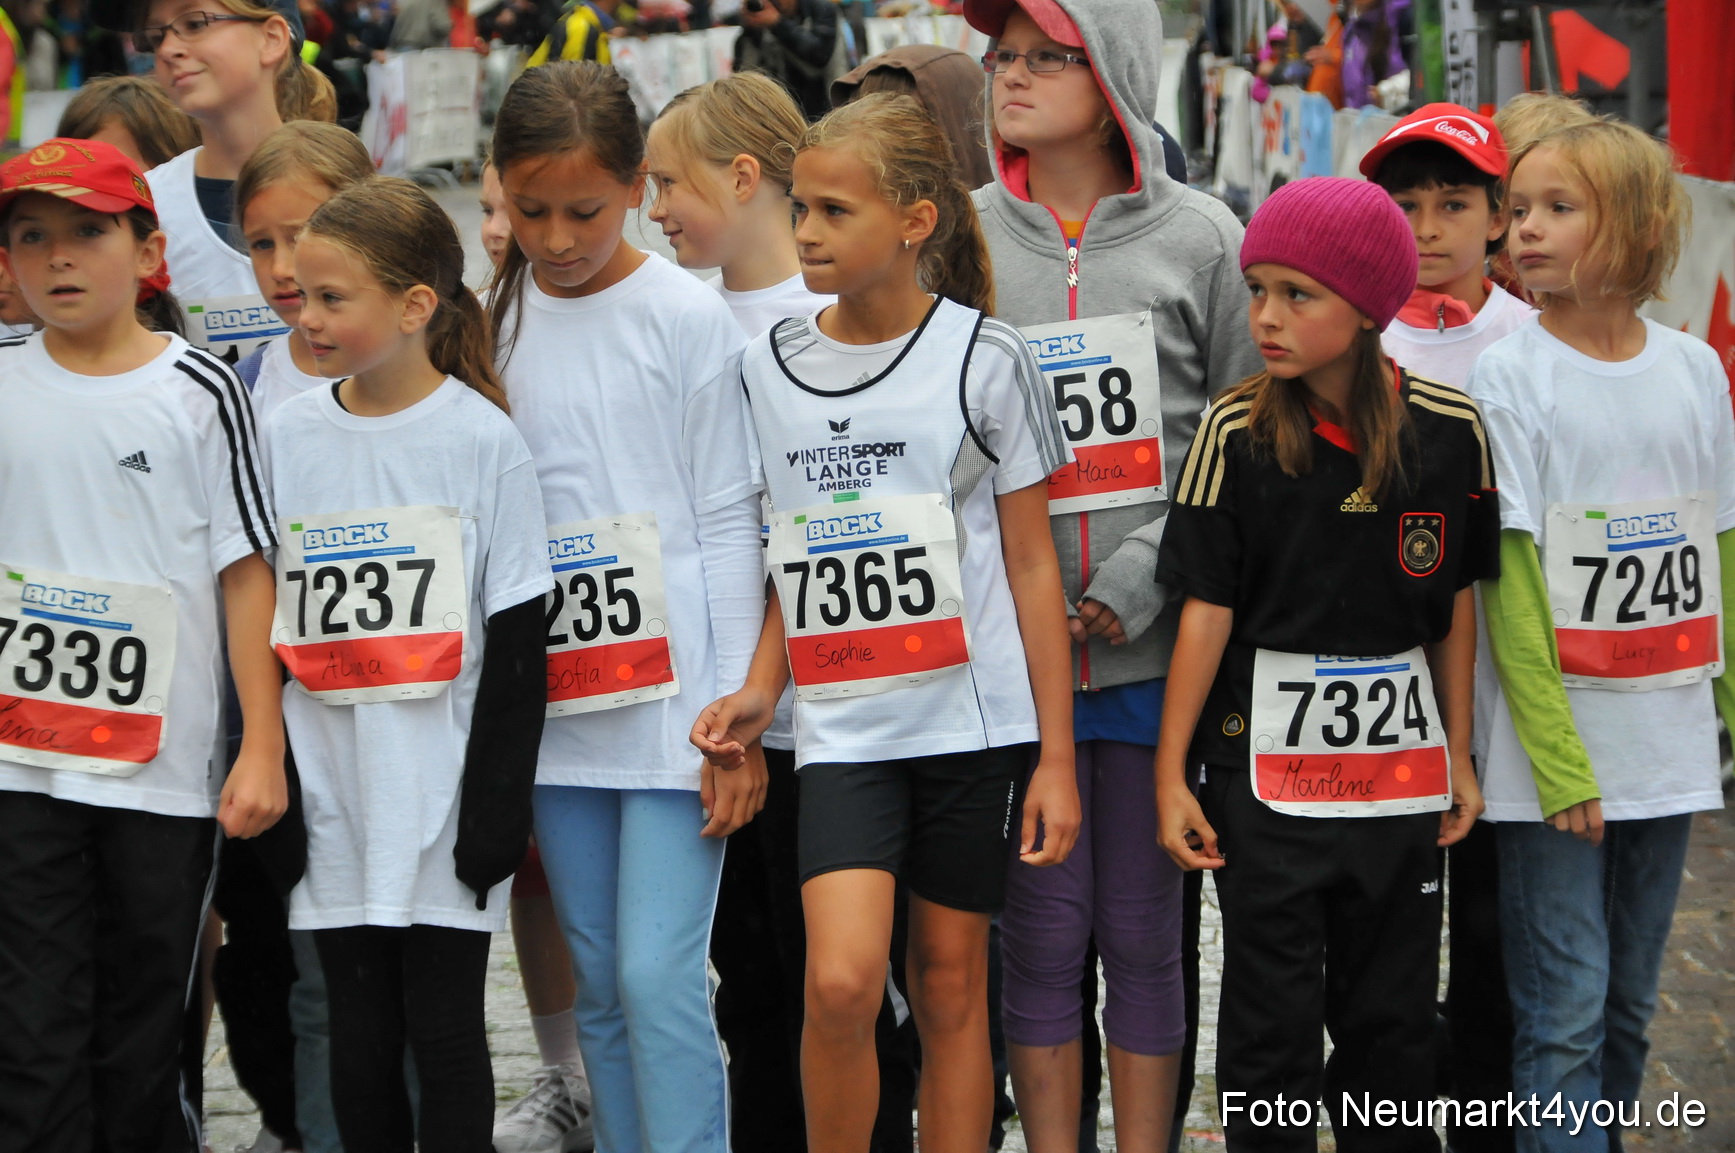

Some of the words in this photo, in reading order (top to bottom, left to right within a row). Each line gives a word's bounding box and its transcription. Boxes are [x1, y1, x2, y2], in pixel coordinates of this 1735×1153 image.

[205, 306, 280, 330] BOCK
[1028, 333, 1086, 359] OCK
[1053, 367, 1137, 442] 58
[118, 459, 151, 473] adidas
[801, 442, 906, 465] INTERSPORT
[806, 460, 888, 481] LANGE
[1075, 458, 1127, 483] Maria
[818, 478, 871, 492] AMBERG
[1340, 502, 1378, 512] adidas
[303, 522, 389, 549] BOCK
[806, 512, 883, 541] BOCK
[1607, 511, 1678, 538] BOCK
[548, 534, 595, 559] OCK
[286, 558, 436, 637] 7237
[783, 546, 935, 629] 7365
[1572, 545, 1702, 623] 7249
[22, 584, 111, 613] BOCK
[545, 567, 641, 647] 235
[322, 651, 384, 680] Alina
[815, 641, 875, 668] Sophie
[1612, 641, 1656, 671] Lucy
[1278, 675, 1428, 747] 7324
[1270, 759, 1375, 799] Marlene
